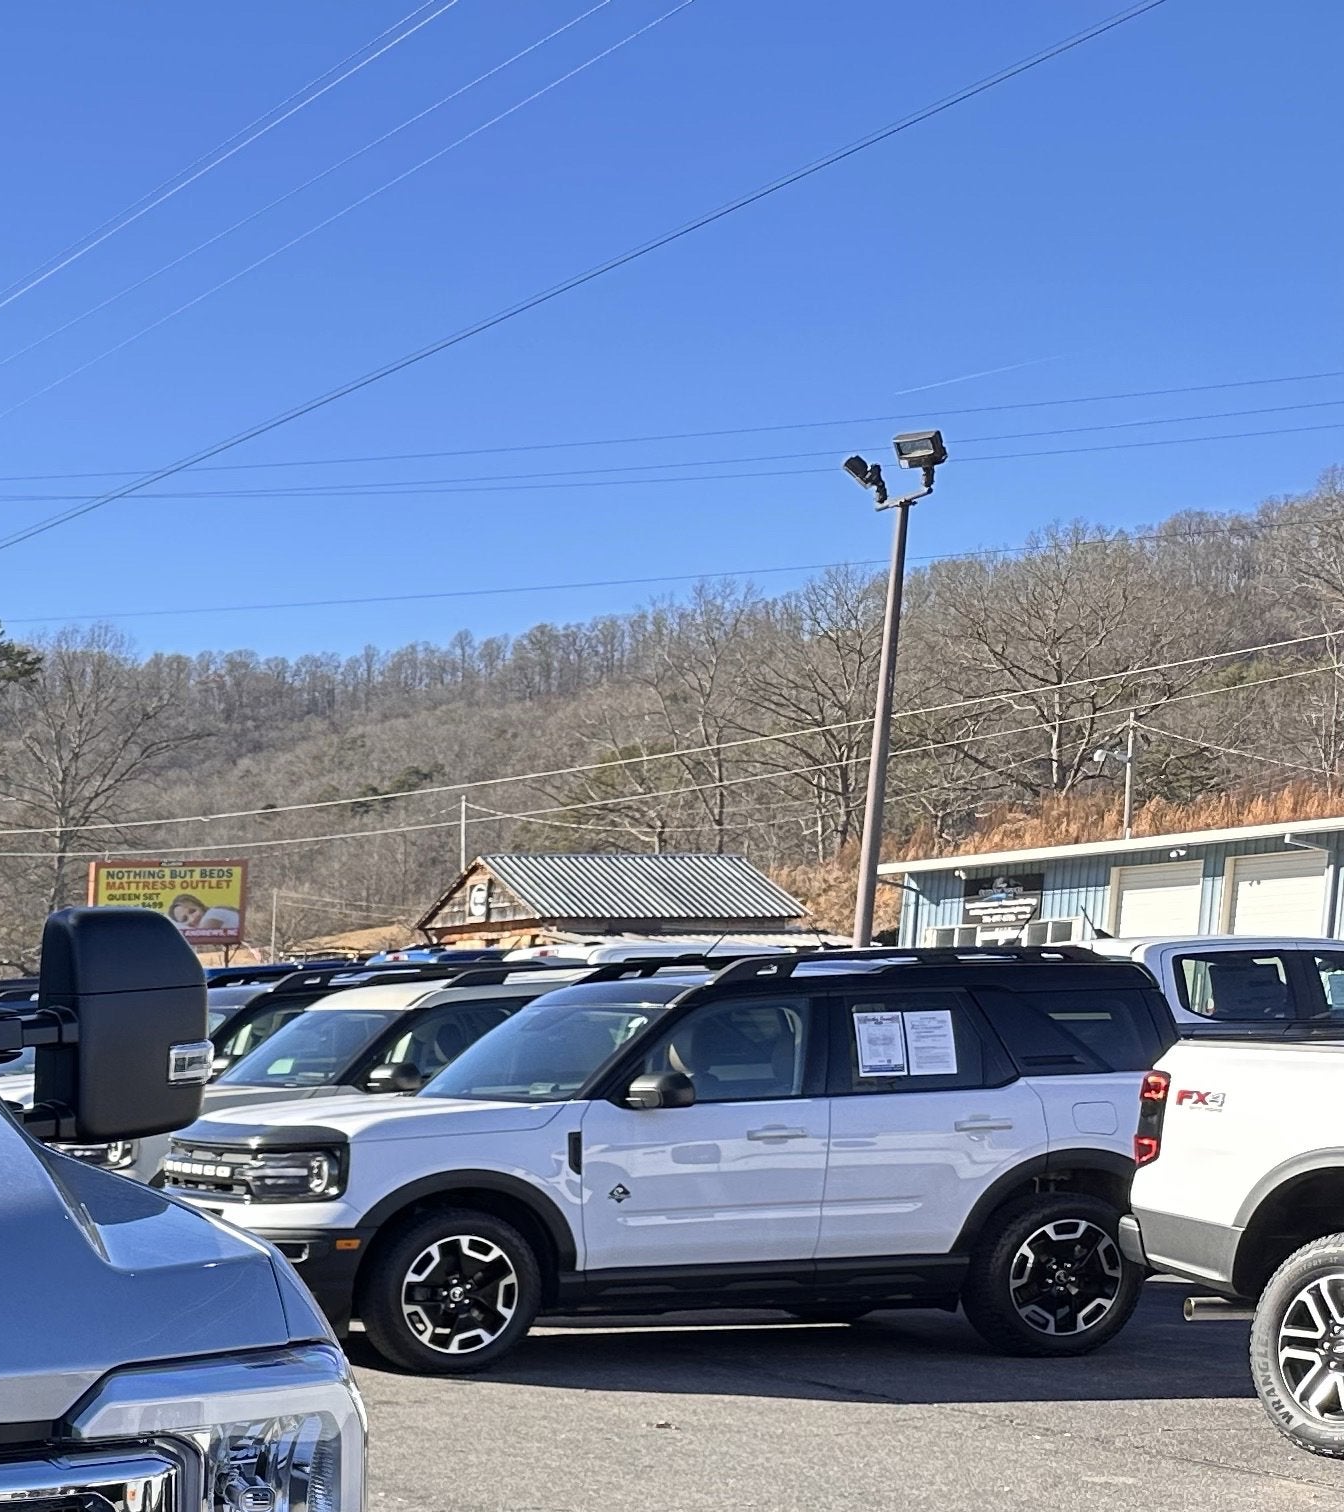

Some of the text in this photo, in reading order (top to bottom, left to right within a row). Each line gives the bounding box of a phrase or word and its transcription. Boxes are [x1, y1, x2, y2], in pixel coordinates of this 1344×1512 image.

[106, 868, 233, 880] NOTHING BUT BEDS
[105, 880, 232, 891] MATTRESS OUTLET
[107, 893, 161, 901] QUEEN SET
[1176, 1089, 1226, 1107] FX4
